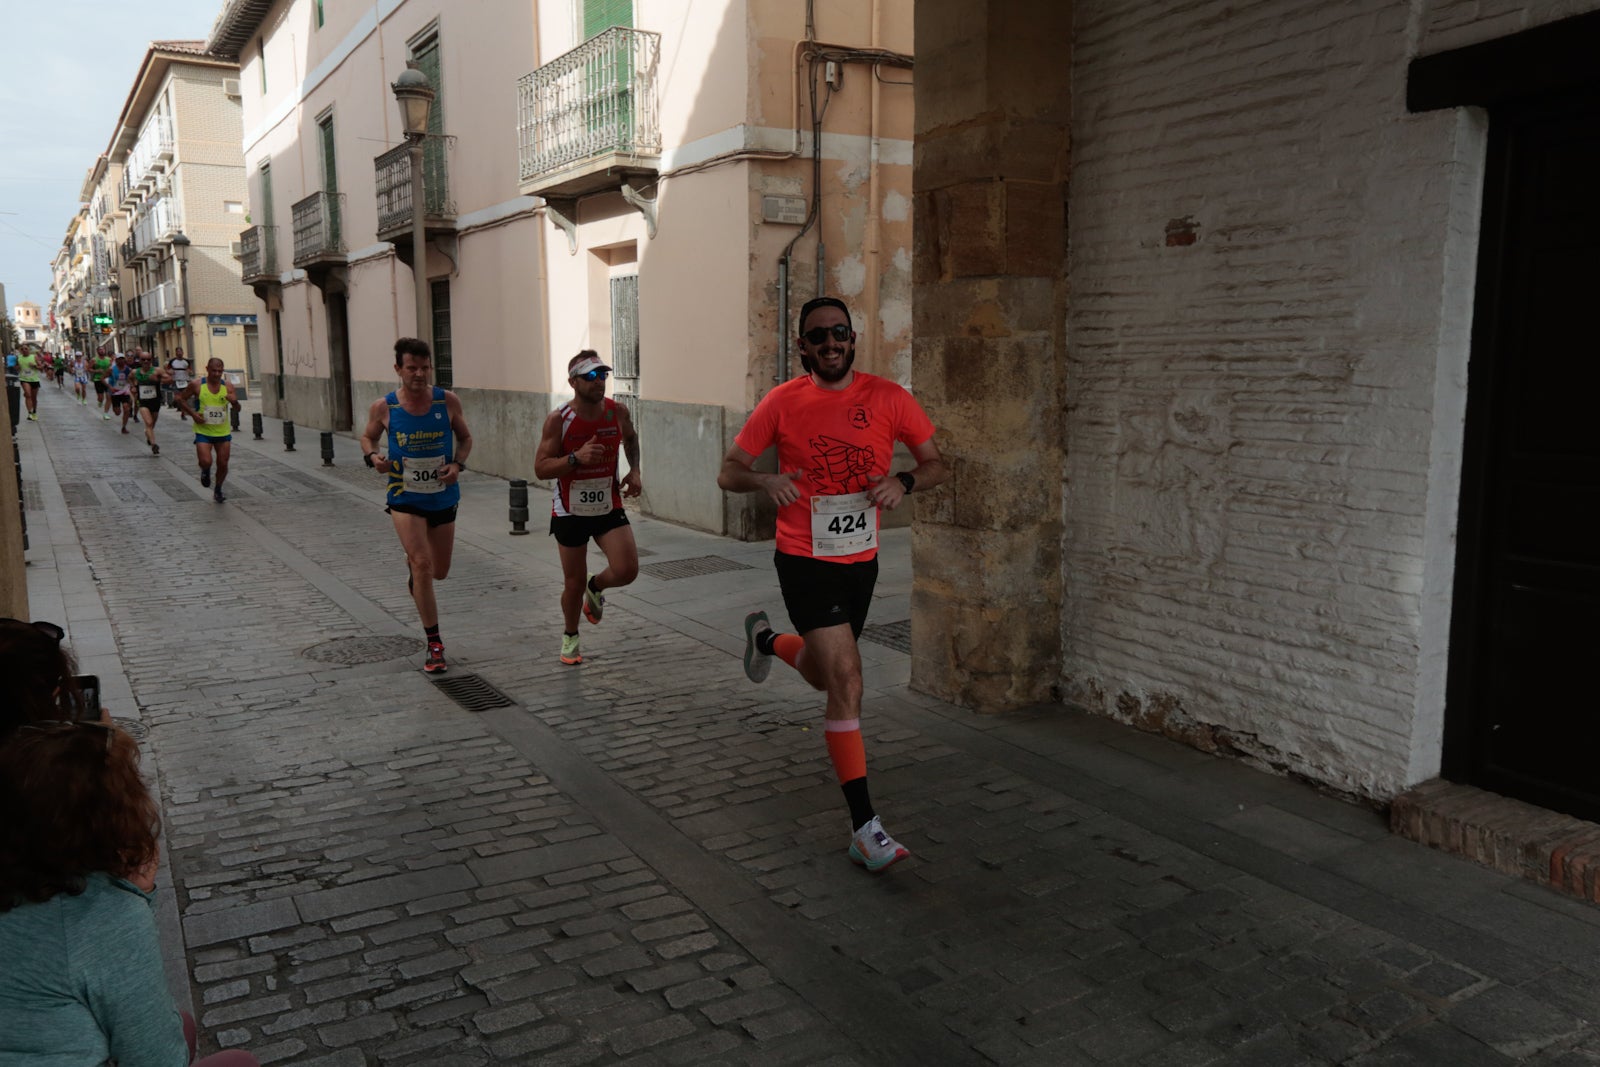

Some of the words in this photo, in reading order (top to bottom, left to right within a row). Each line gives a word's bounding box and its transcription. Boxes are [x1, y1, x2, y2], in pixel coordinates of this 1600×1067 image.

[409, 430, 444, 440] olimpo
[412, 469, 439, 482] 304
[579, 490, 605, 504] 390
[828, 511, 867, 535] 424
